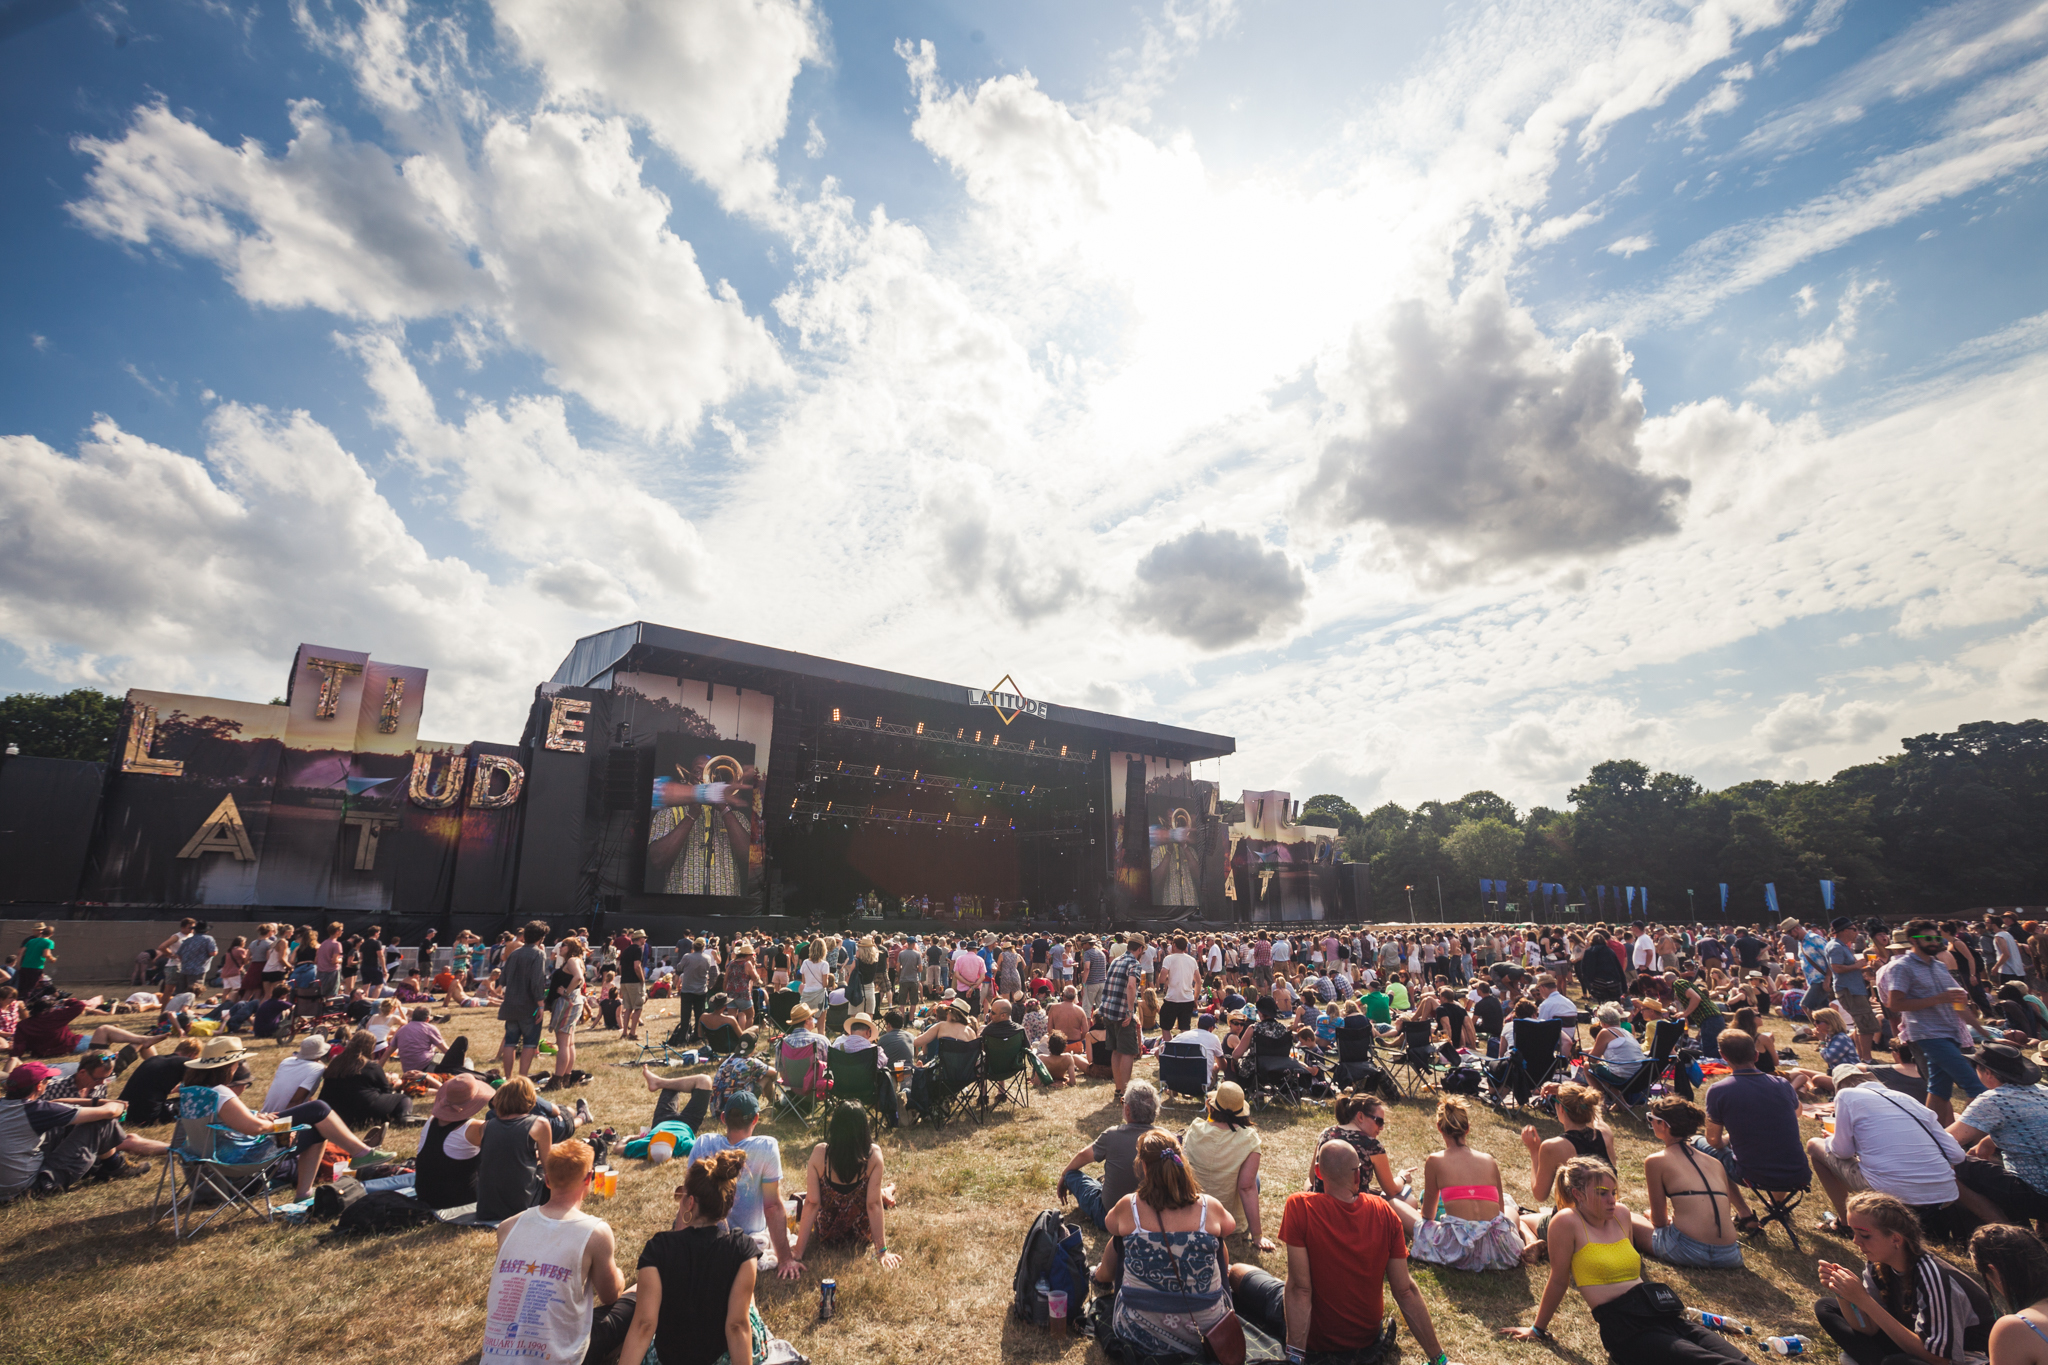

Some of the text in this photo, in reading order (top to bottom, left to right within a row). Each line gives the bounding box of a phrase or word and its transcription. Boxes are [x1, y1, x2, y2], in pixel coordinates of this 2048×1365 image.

[969, 690, 1047, 718] LATITUDE
[499, 1259, 572, 1282] EAST WEST
[528, 1341, 547, 1351] 1990
